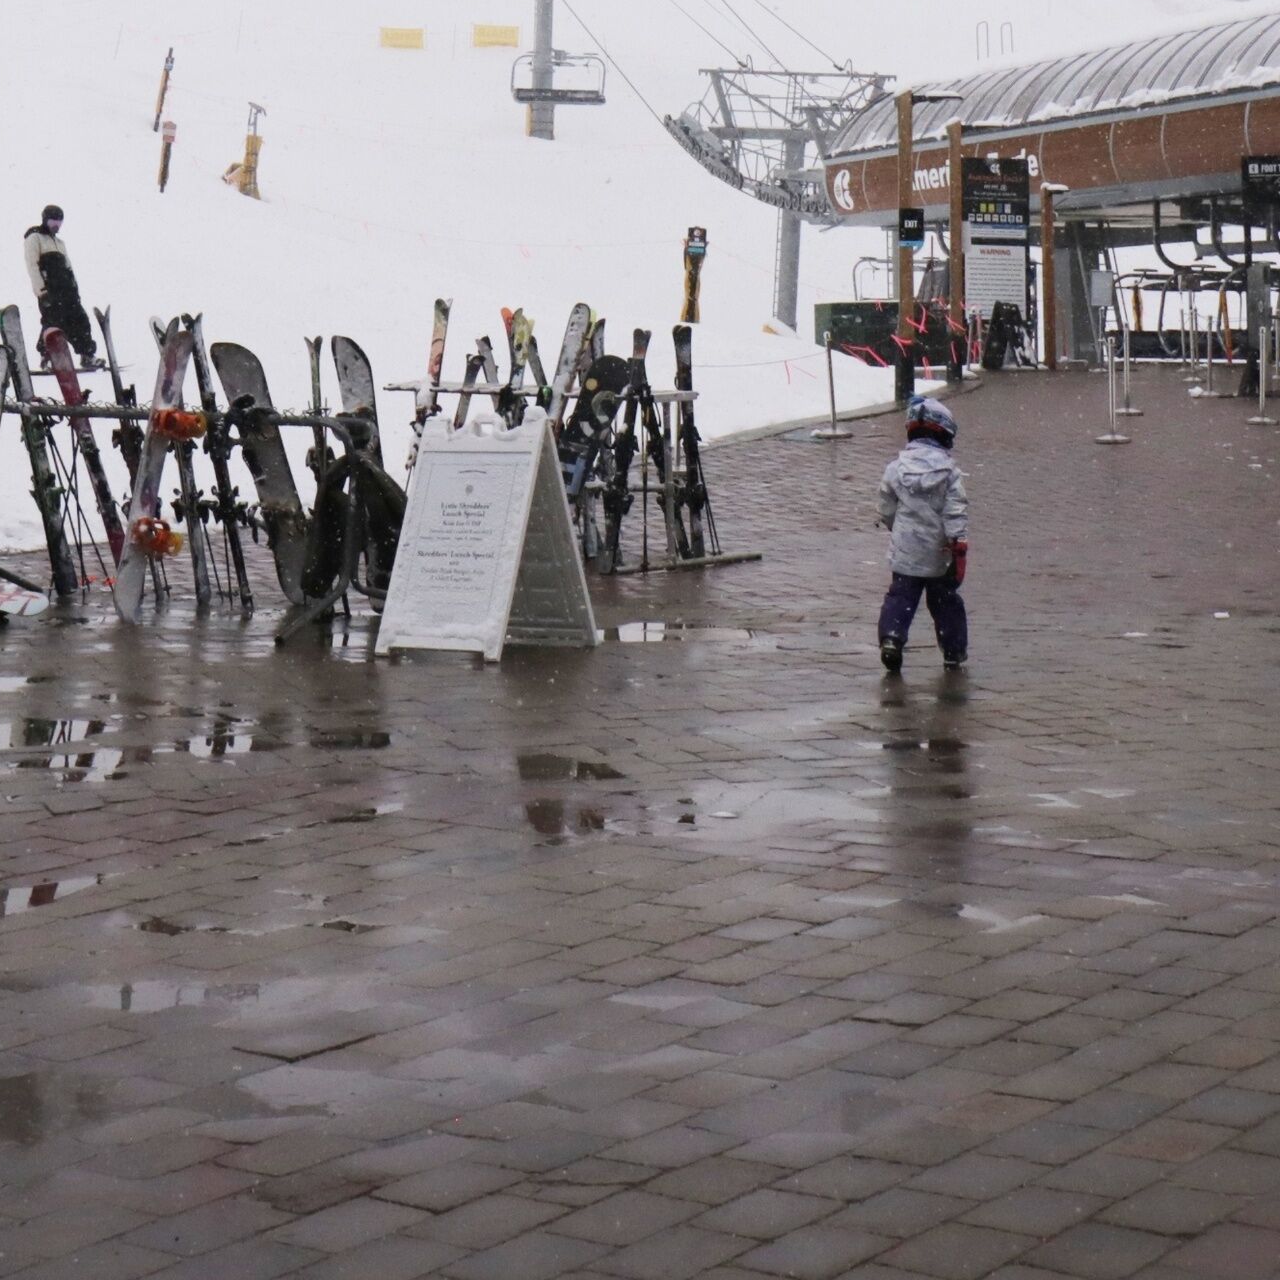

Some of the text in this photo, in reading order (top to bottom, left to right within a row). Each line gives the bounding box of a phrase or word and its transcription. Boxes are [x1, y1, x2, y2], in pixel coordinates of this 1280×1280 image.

[1261, 164, 1277, 173] FOOT
[904, 219, 918, 229] EXIT
[980, 248, 1011, 256] WARNING
